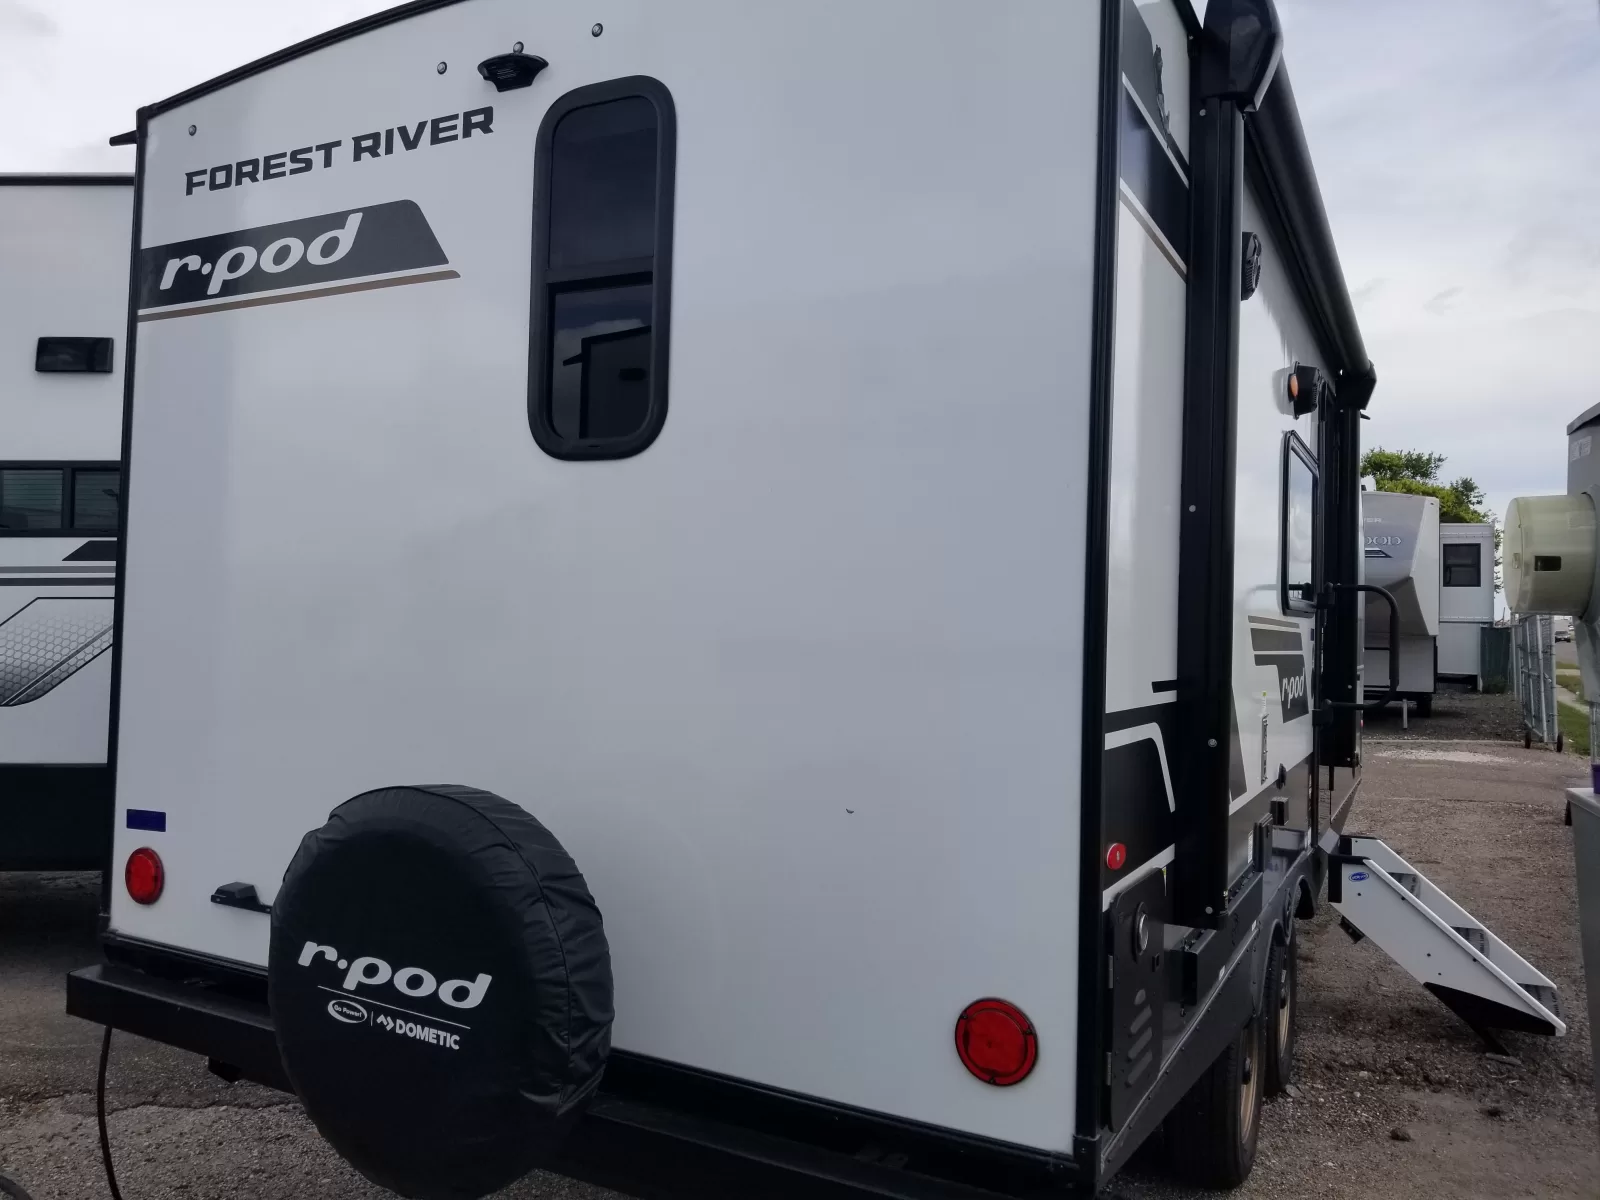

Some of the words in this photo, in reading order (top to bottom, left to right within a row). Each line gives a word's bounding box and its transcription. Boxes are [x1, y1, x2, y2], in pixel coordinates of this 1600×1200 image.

[185, 139, 342, 196] FOREST
[352, 106, 494, 162] RIVER
[395, 1018, 461, 1050] DOMETIC
